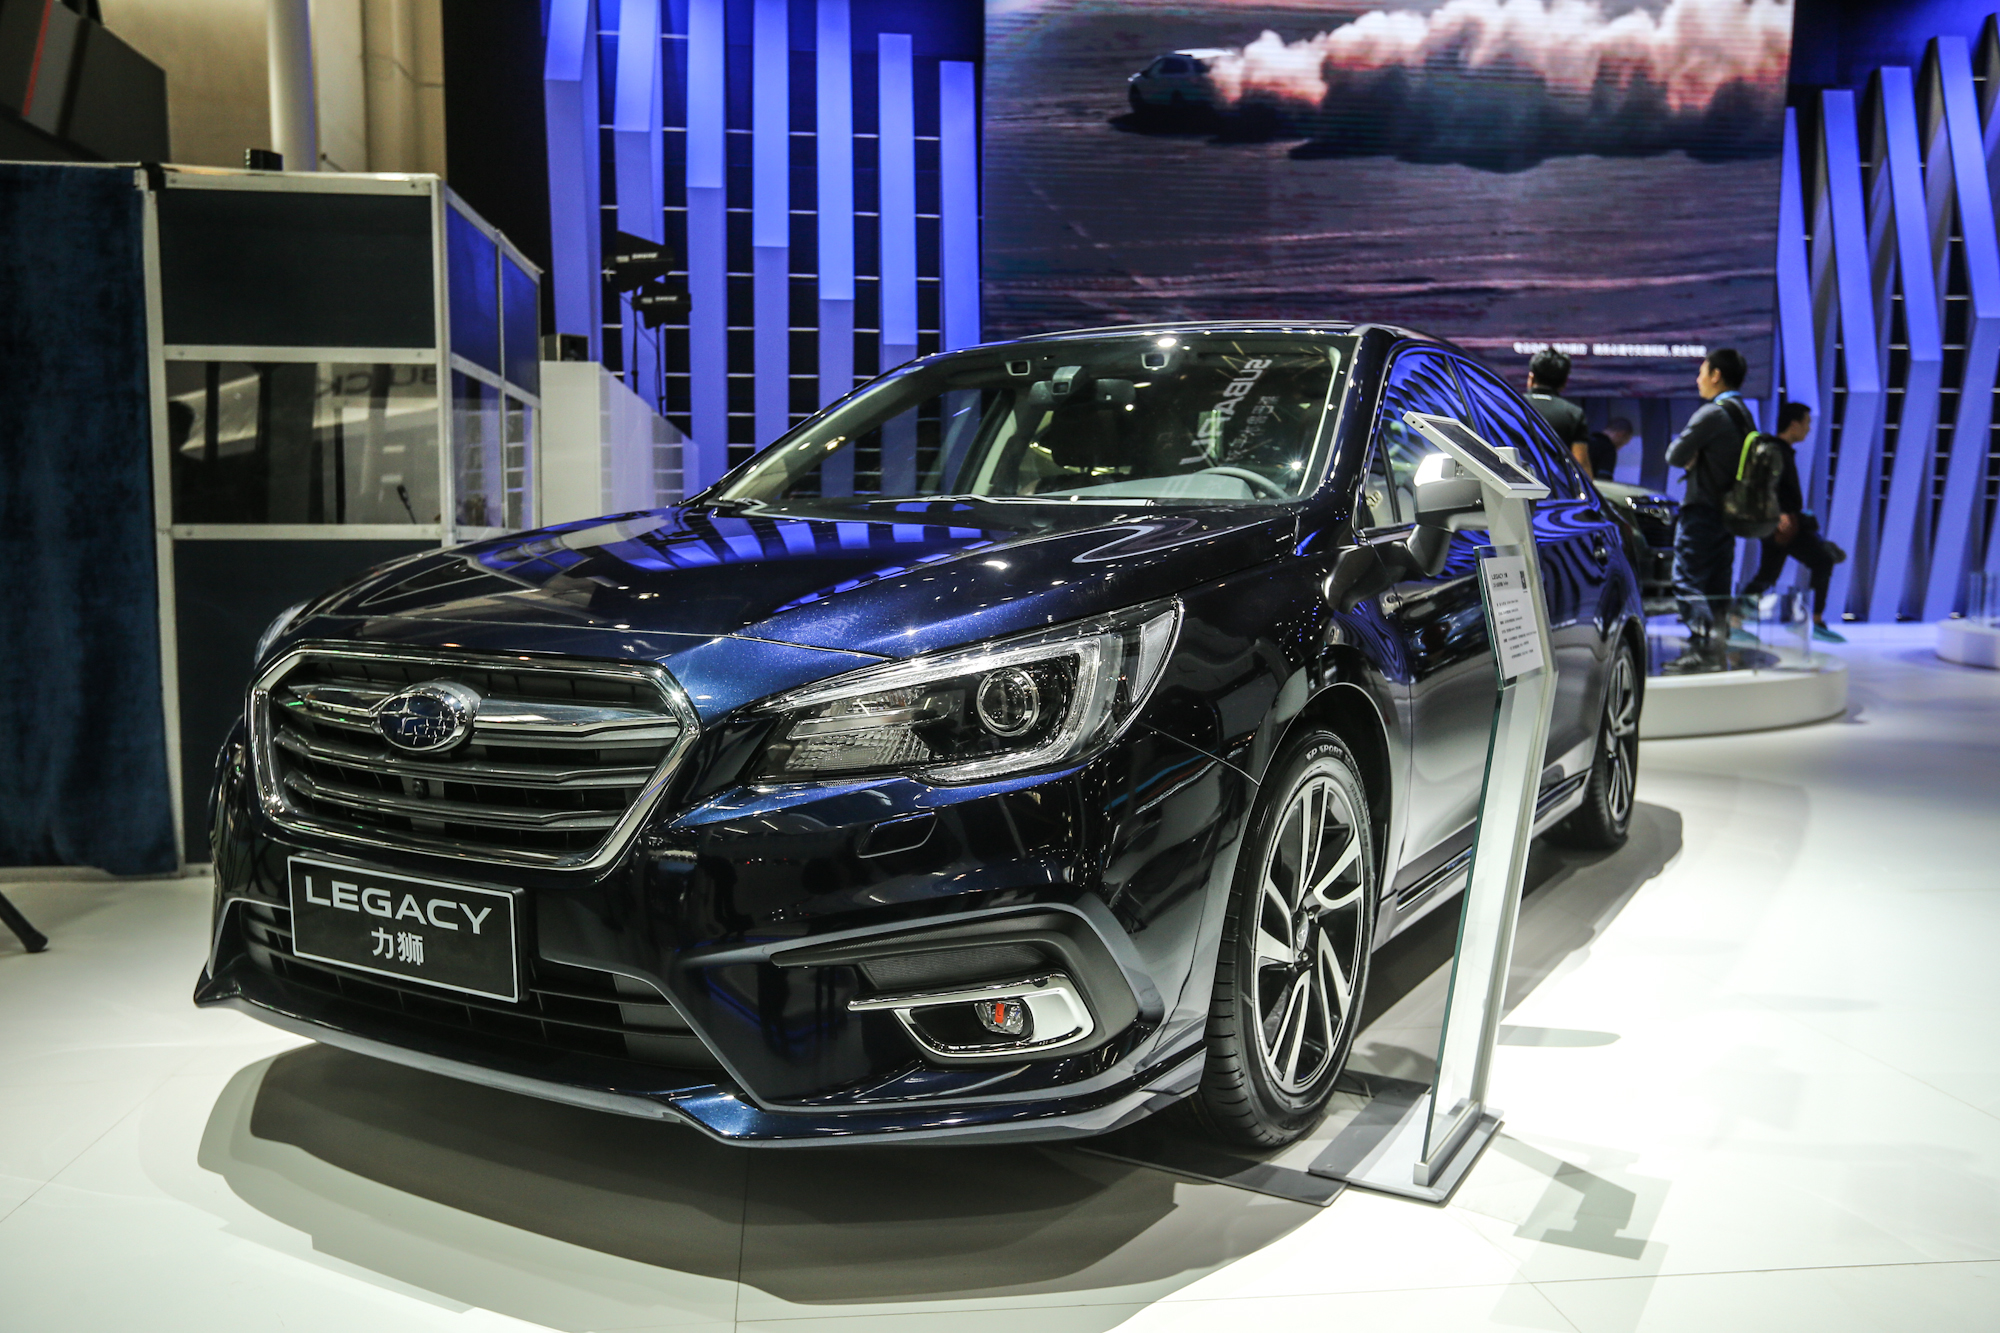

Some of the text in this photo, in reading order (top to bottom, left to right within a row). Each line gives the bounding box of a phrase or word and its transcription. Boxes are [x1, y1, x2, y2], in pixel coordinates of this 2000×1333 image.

[1305, 744, 1343, 761] SP SPORT
[304, 875, 492, 935] LEGACY
[370, 926, 425, 966] 力狮
